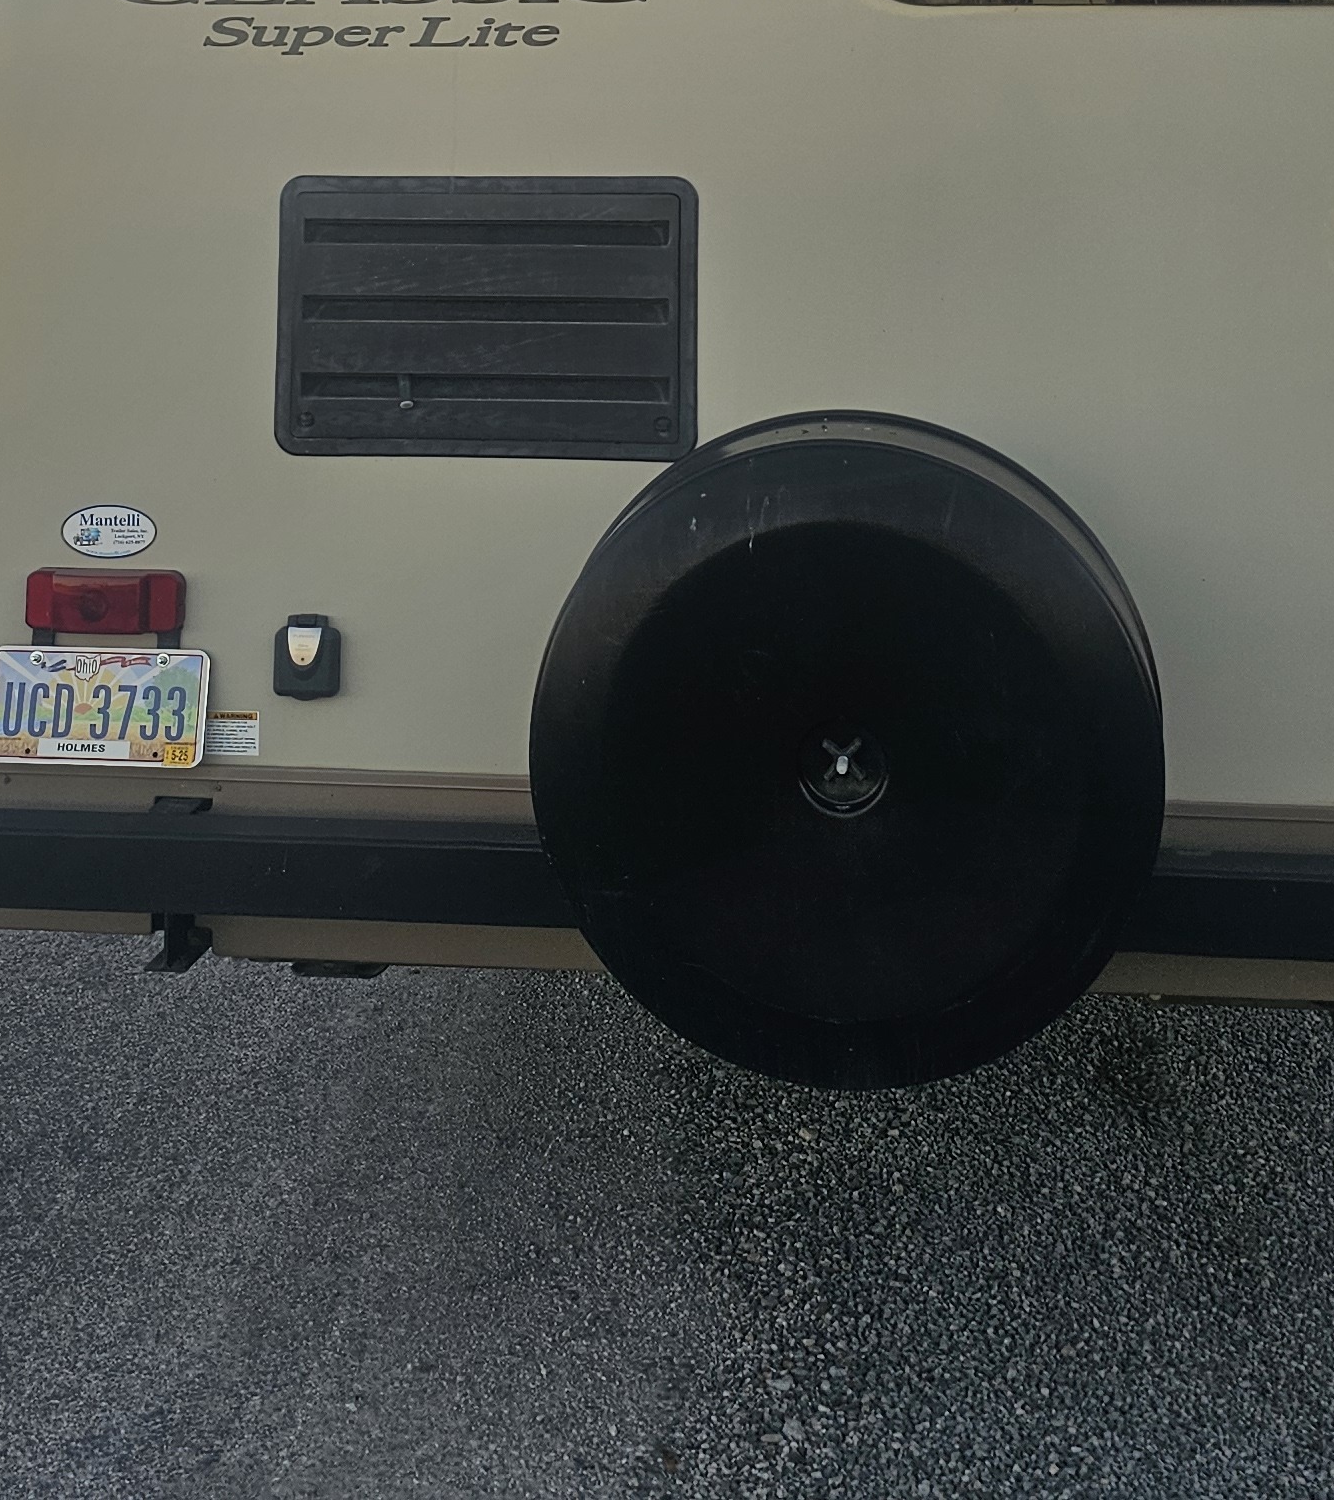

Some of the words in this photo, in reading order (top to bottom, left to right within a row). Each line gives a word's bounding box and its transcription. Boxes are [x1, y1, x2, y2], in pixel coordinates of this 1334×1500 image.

[203, 16, 405, 56] Super
[410, 15, 561, 48] Lite
[79, 513, 141, 527] Mantelli
[2, 681, 75, 738] UCD
[89, 684, 187, 741] 3733
[57, 742, 106, 753] HOLMES
[171, 749, 189, 761] 5-25
